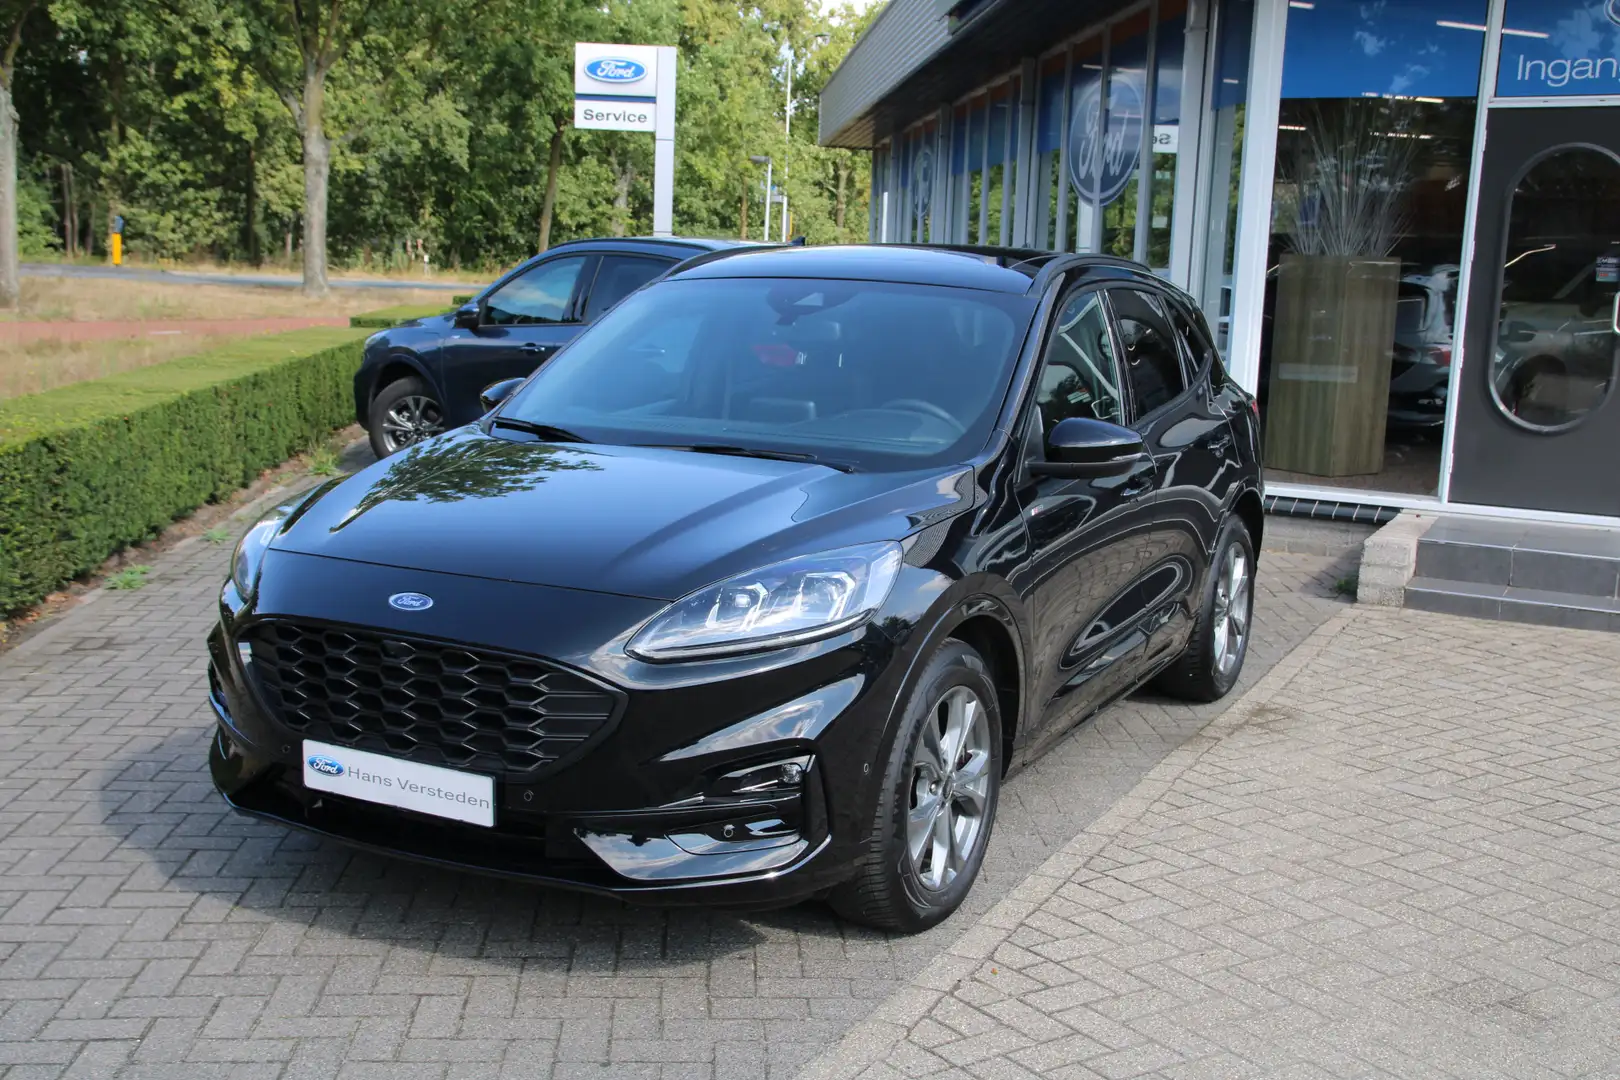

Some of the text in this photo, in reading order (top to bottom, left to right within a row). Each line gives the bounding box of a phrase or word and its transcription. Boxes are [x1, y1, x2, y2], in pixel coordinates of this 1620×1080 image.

[597, 60, 636, 78] Ford
[1517, 54, 1620, 87] Ingan
[583, 108, 647, 123] Service
[397, 595, 424, 607] Ford
[313, 757, 490, 809] Ford Hans Versteden
